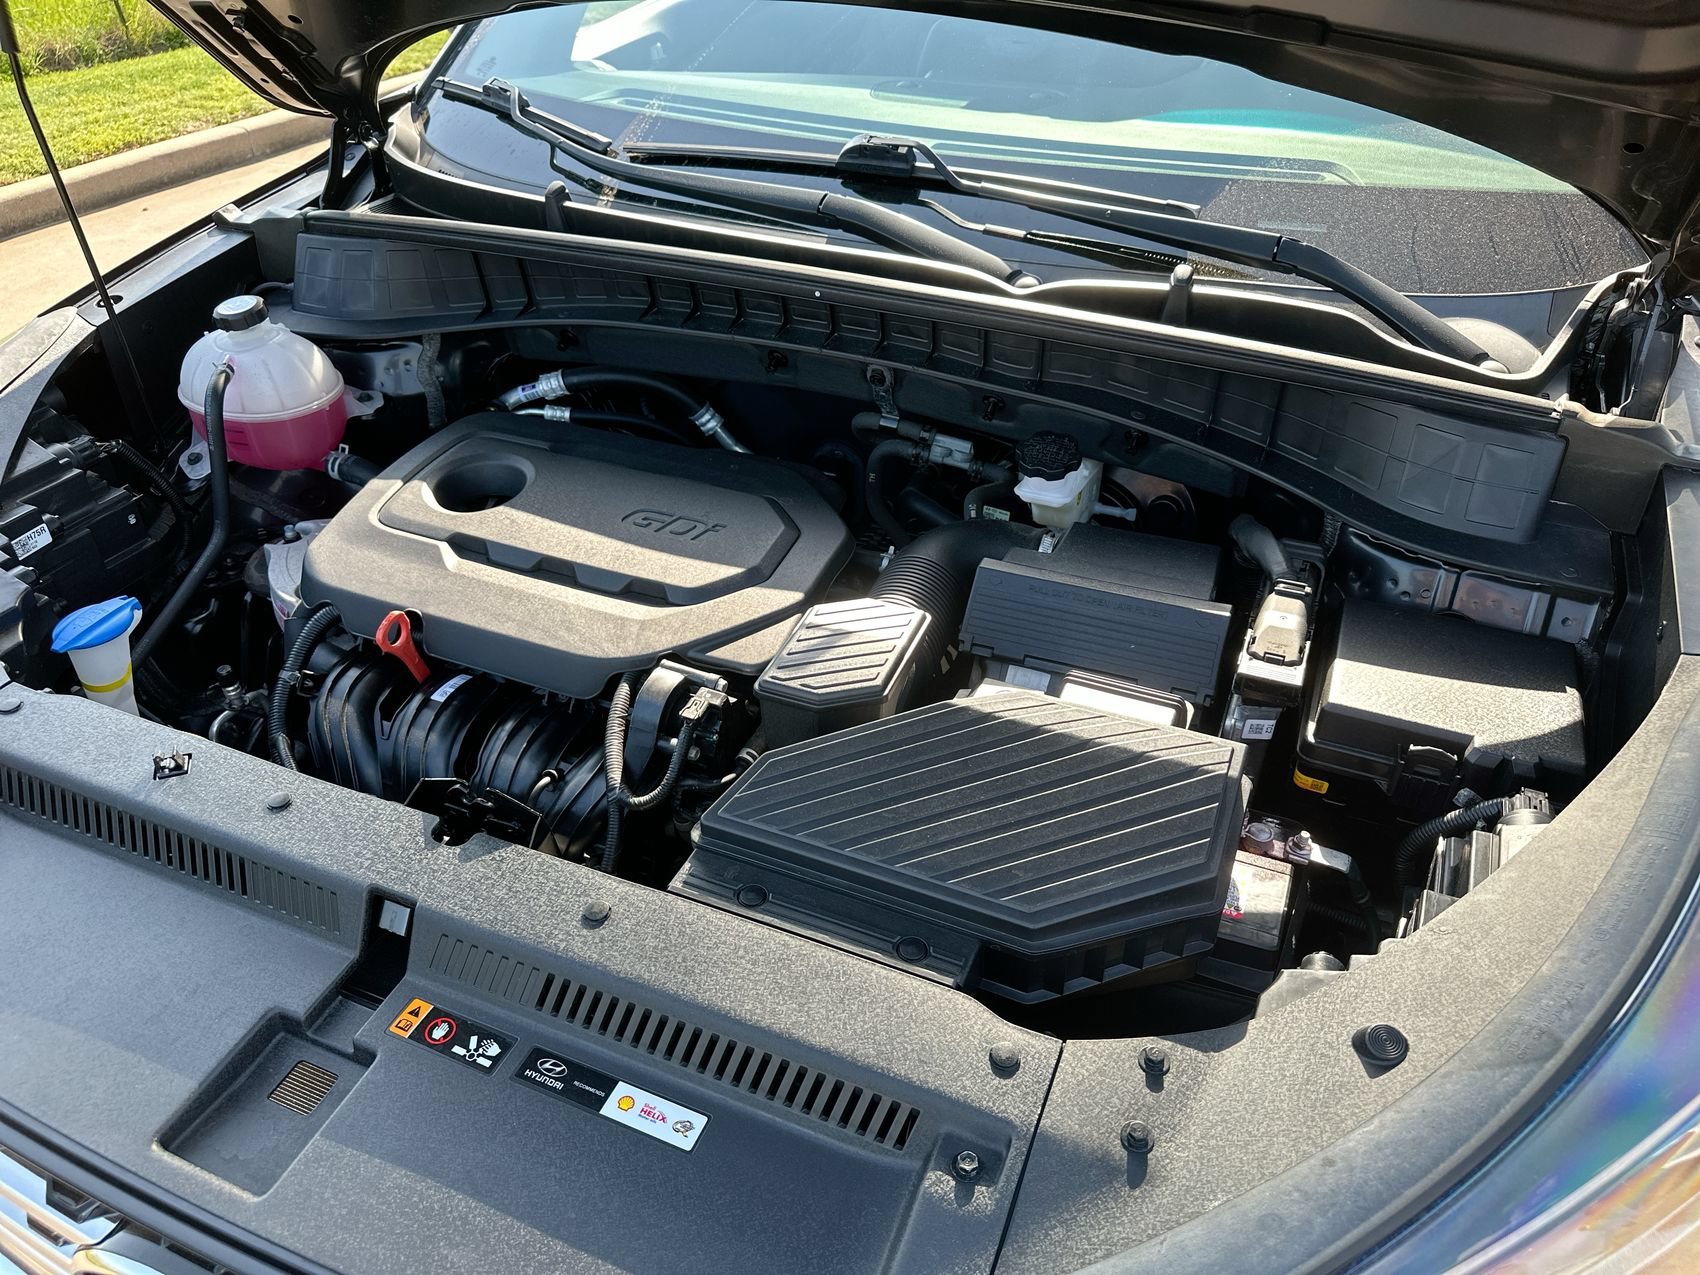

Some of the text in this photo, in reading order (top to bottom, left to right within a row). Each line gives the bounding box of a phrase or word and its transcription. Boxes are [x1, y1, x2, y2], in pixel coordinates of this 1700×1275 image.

[26, 526, 47, 542] H75R
[1029, 584, 1048, 595] PULL
[1086, 596, 1112, 608] OPEN
[524, 1069, 564, 1091] HYUNDAI
[573, 1081, 605, 1097] RECOMMENDS
[639, 1107, 667, 1124] HELIX
